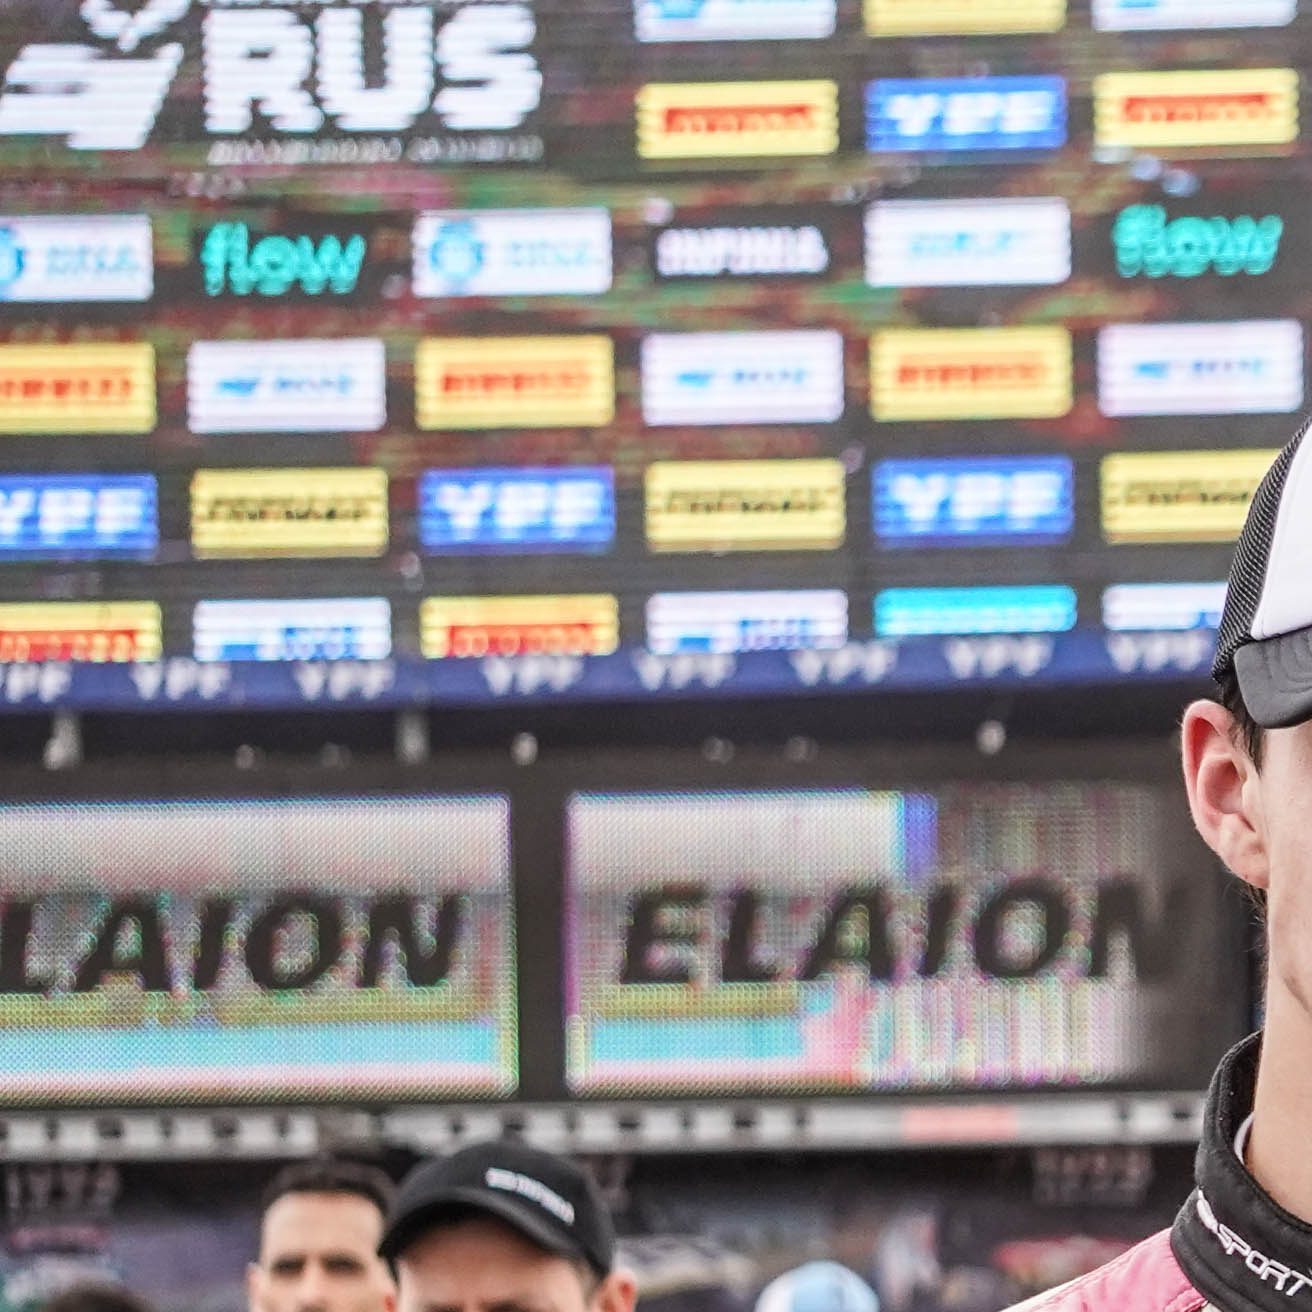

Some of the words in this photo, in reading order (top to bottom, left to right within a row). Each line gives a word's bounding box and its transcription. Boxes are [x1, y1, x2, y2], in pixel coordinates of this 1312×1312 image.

[203, 221, 366, 296] flow
[435, 480, 605, 540] YPF
[889, 470, 1064, 533] YPF
